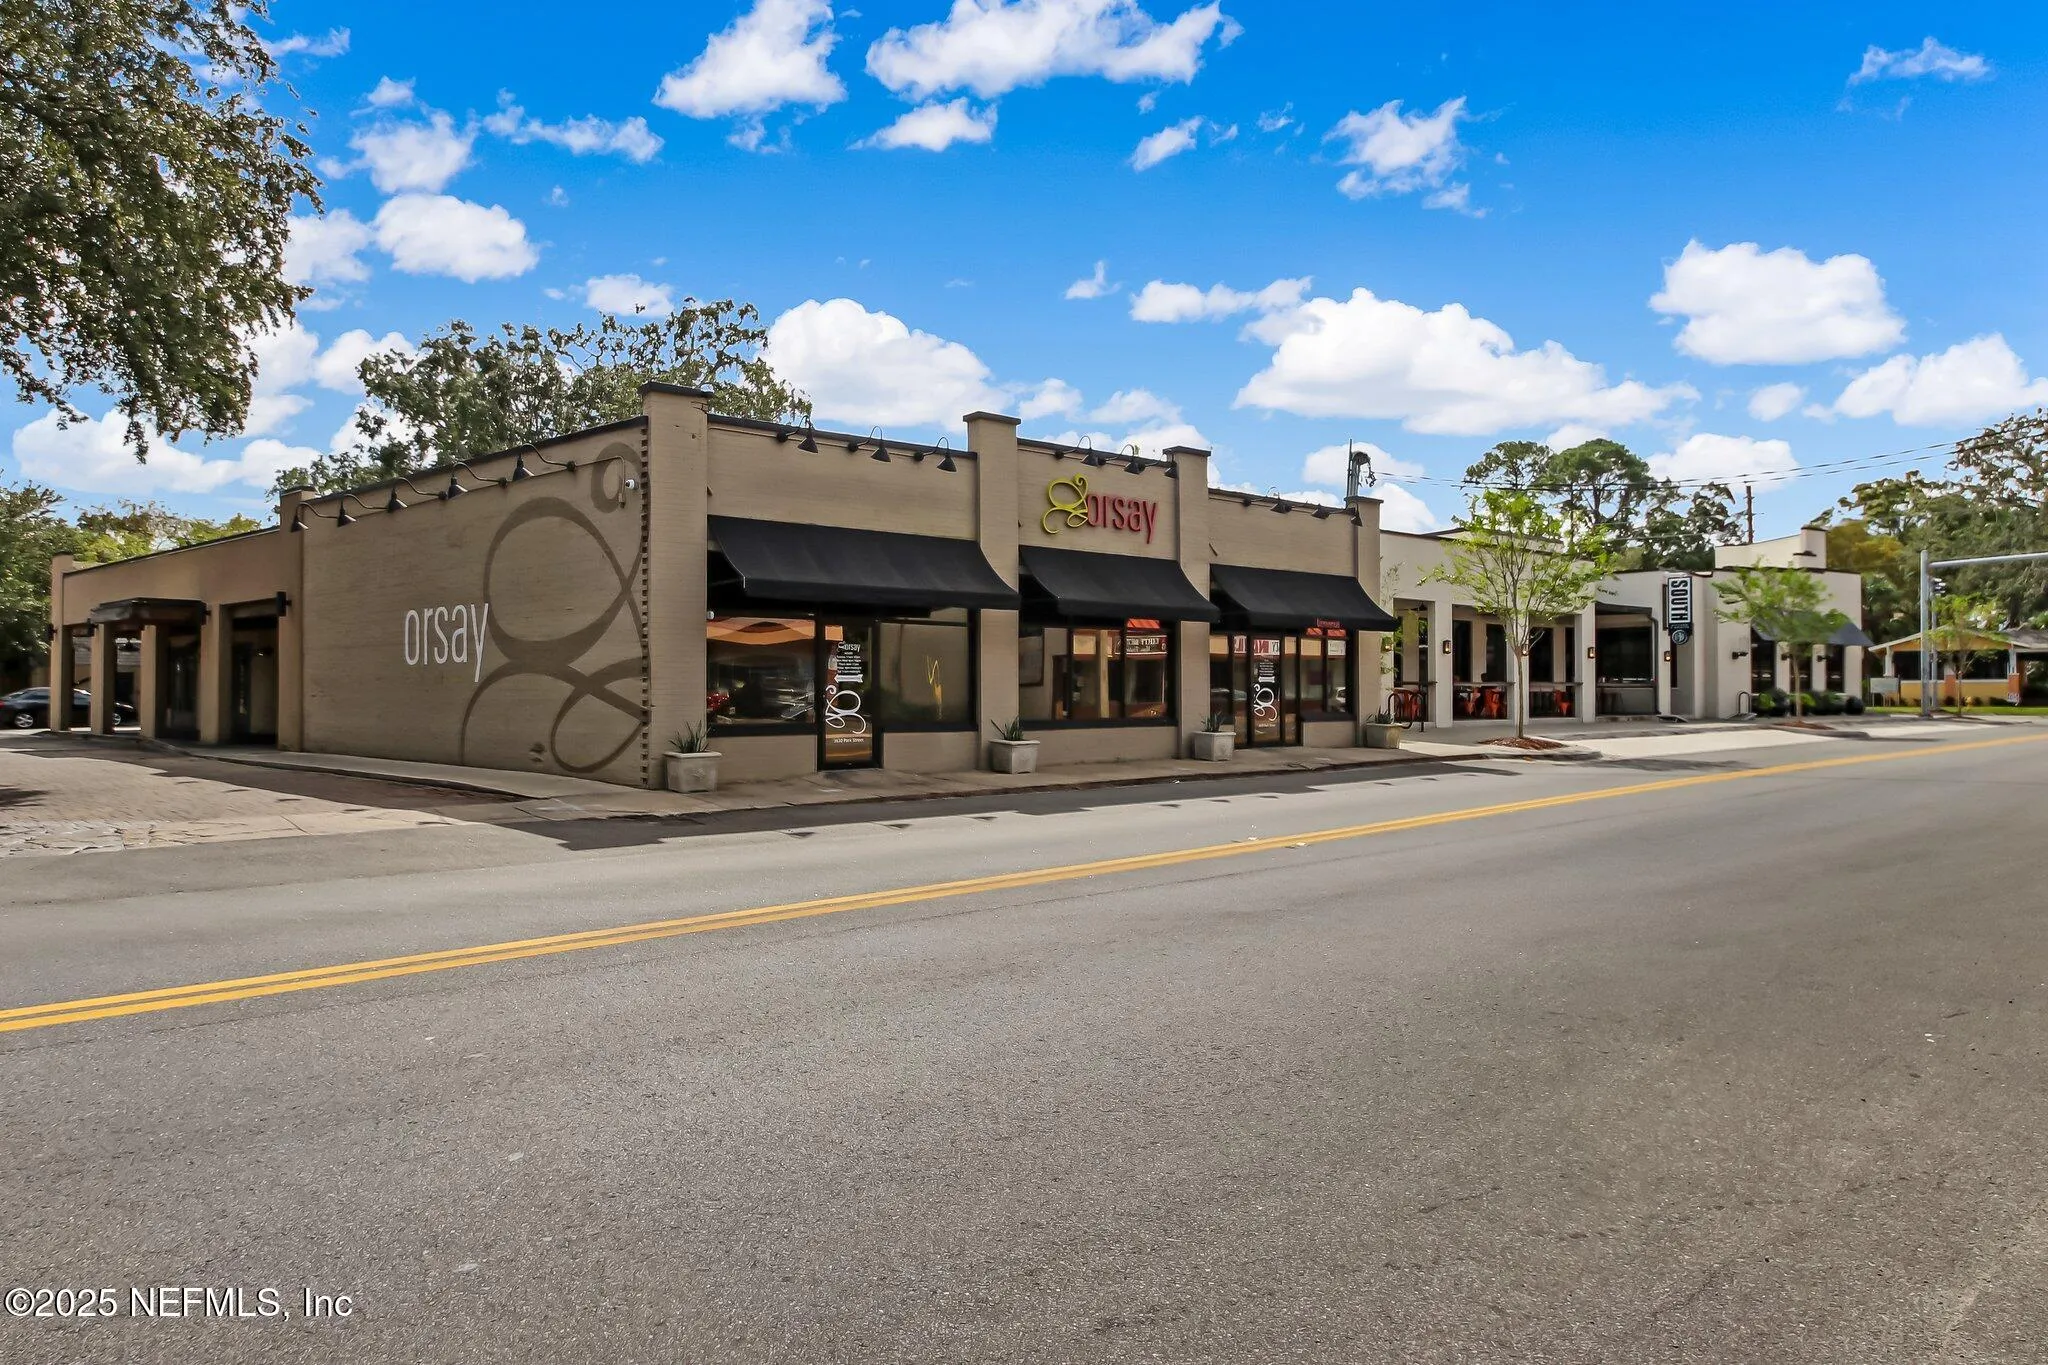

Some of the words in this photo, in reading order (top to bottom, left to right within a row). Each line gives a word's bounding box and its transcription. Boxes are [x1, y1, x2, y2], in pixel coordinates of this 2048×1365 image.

[1087, 494, 1157, 544] orsay
[1671, 580, 1689, 621] SOUTH
[405, 603, 489, 683] orsay
